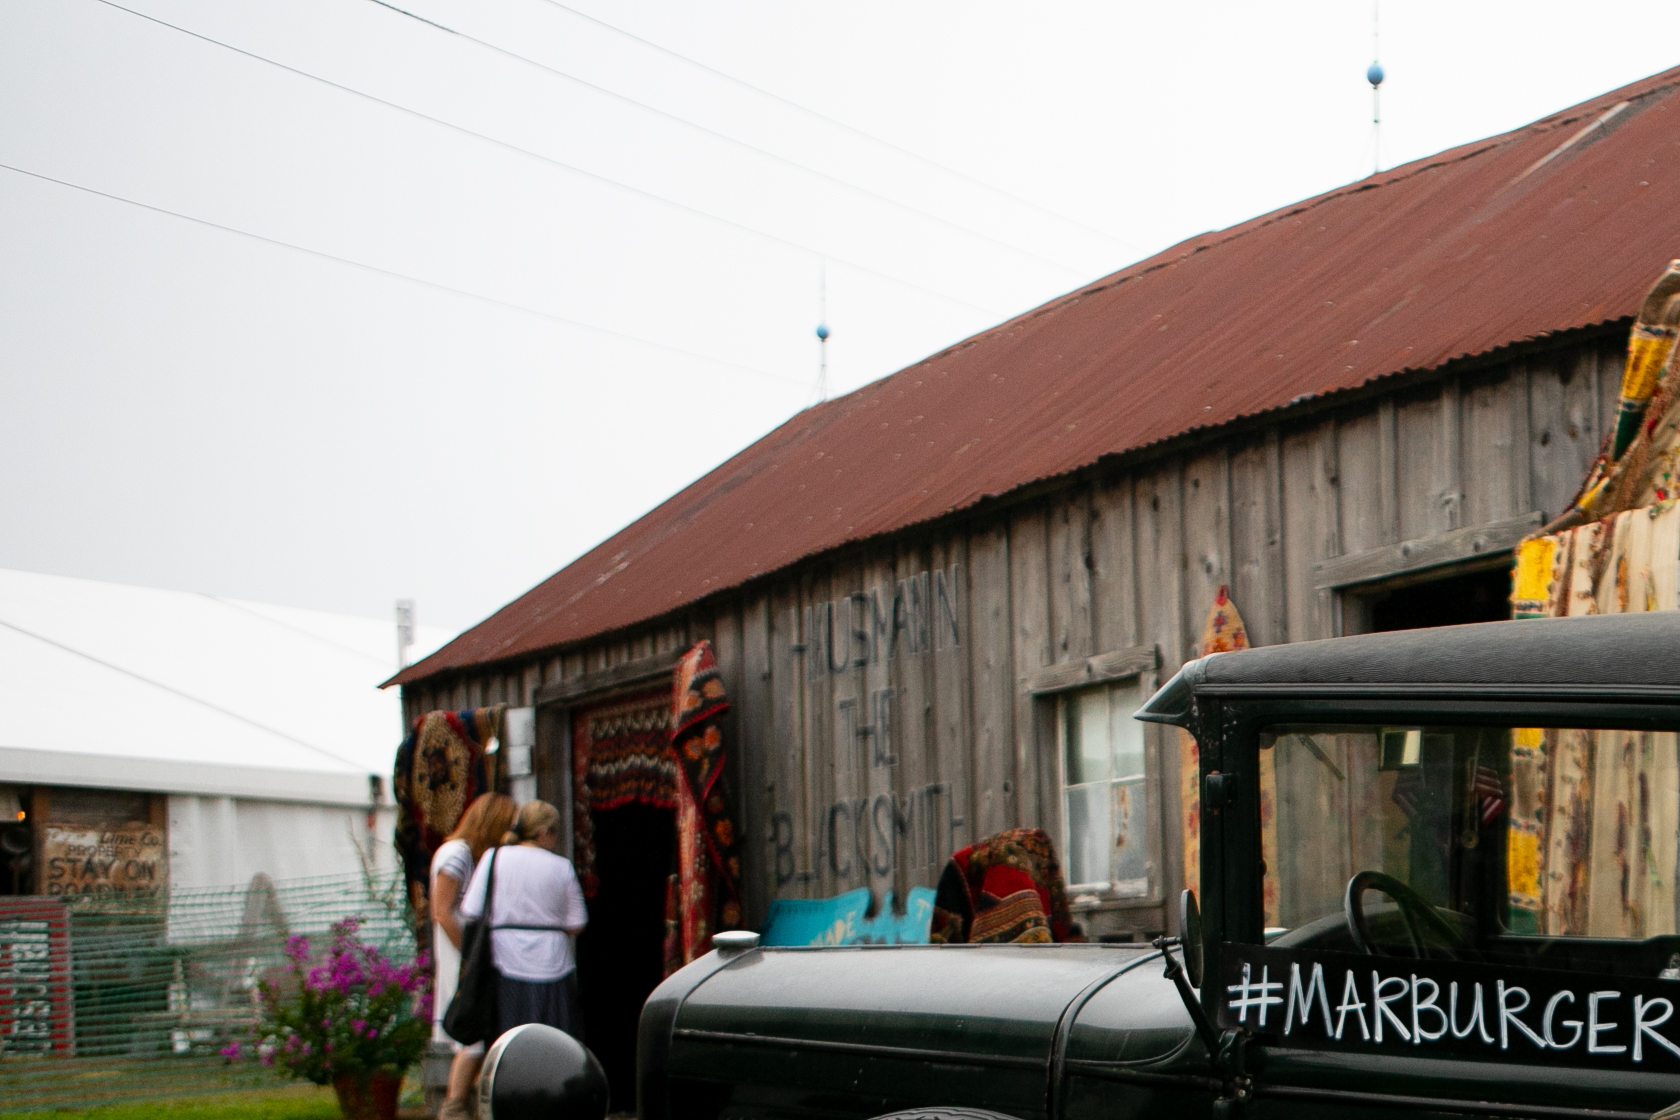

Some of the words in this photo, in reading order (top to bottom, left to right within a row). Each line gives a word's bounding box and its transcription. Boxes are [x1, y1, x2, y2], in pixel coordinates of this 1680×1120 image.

[787, 563, 960, 684] HAUSMANN
[838, 686, 899, 769] THE
[49, 857, 118, 879] STAY
[126, 860, 156, 880] ON
[769, 782, 965, 885] BLACKSMITH
